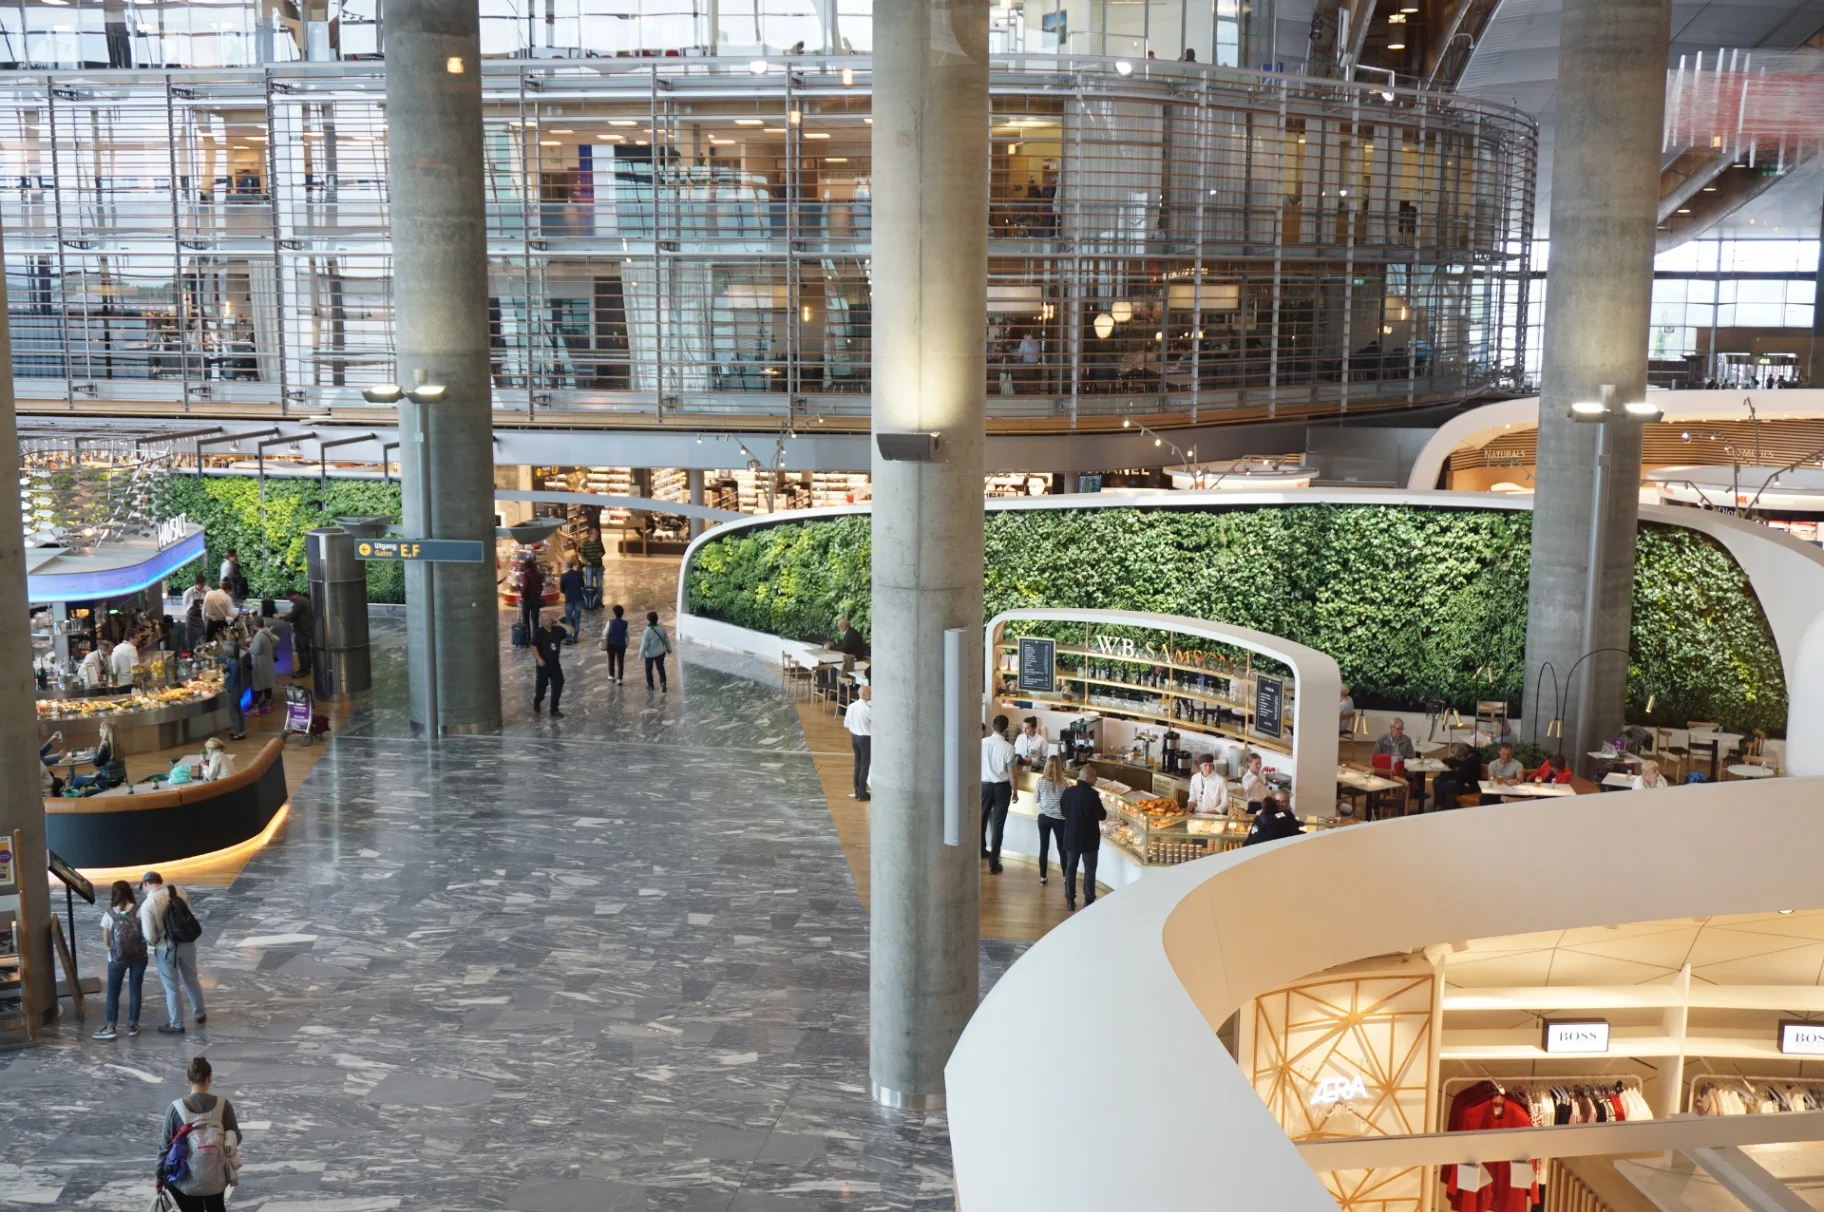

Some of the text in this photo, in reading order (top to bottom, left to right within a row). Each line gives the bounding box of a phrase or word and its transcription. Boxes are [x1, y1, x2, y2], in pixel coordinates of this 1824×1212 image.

[1484, 449, 1526, 459] NATURALS
[1726, 446, 1775, 459] CSMEICS
[374, 542, 397, 551] Utgang
[1096, 635, 1235, 675] W.B. SAMSON
[1559, 1031, 1597, 1042] BOSS
